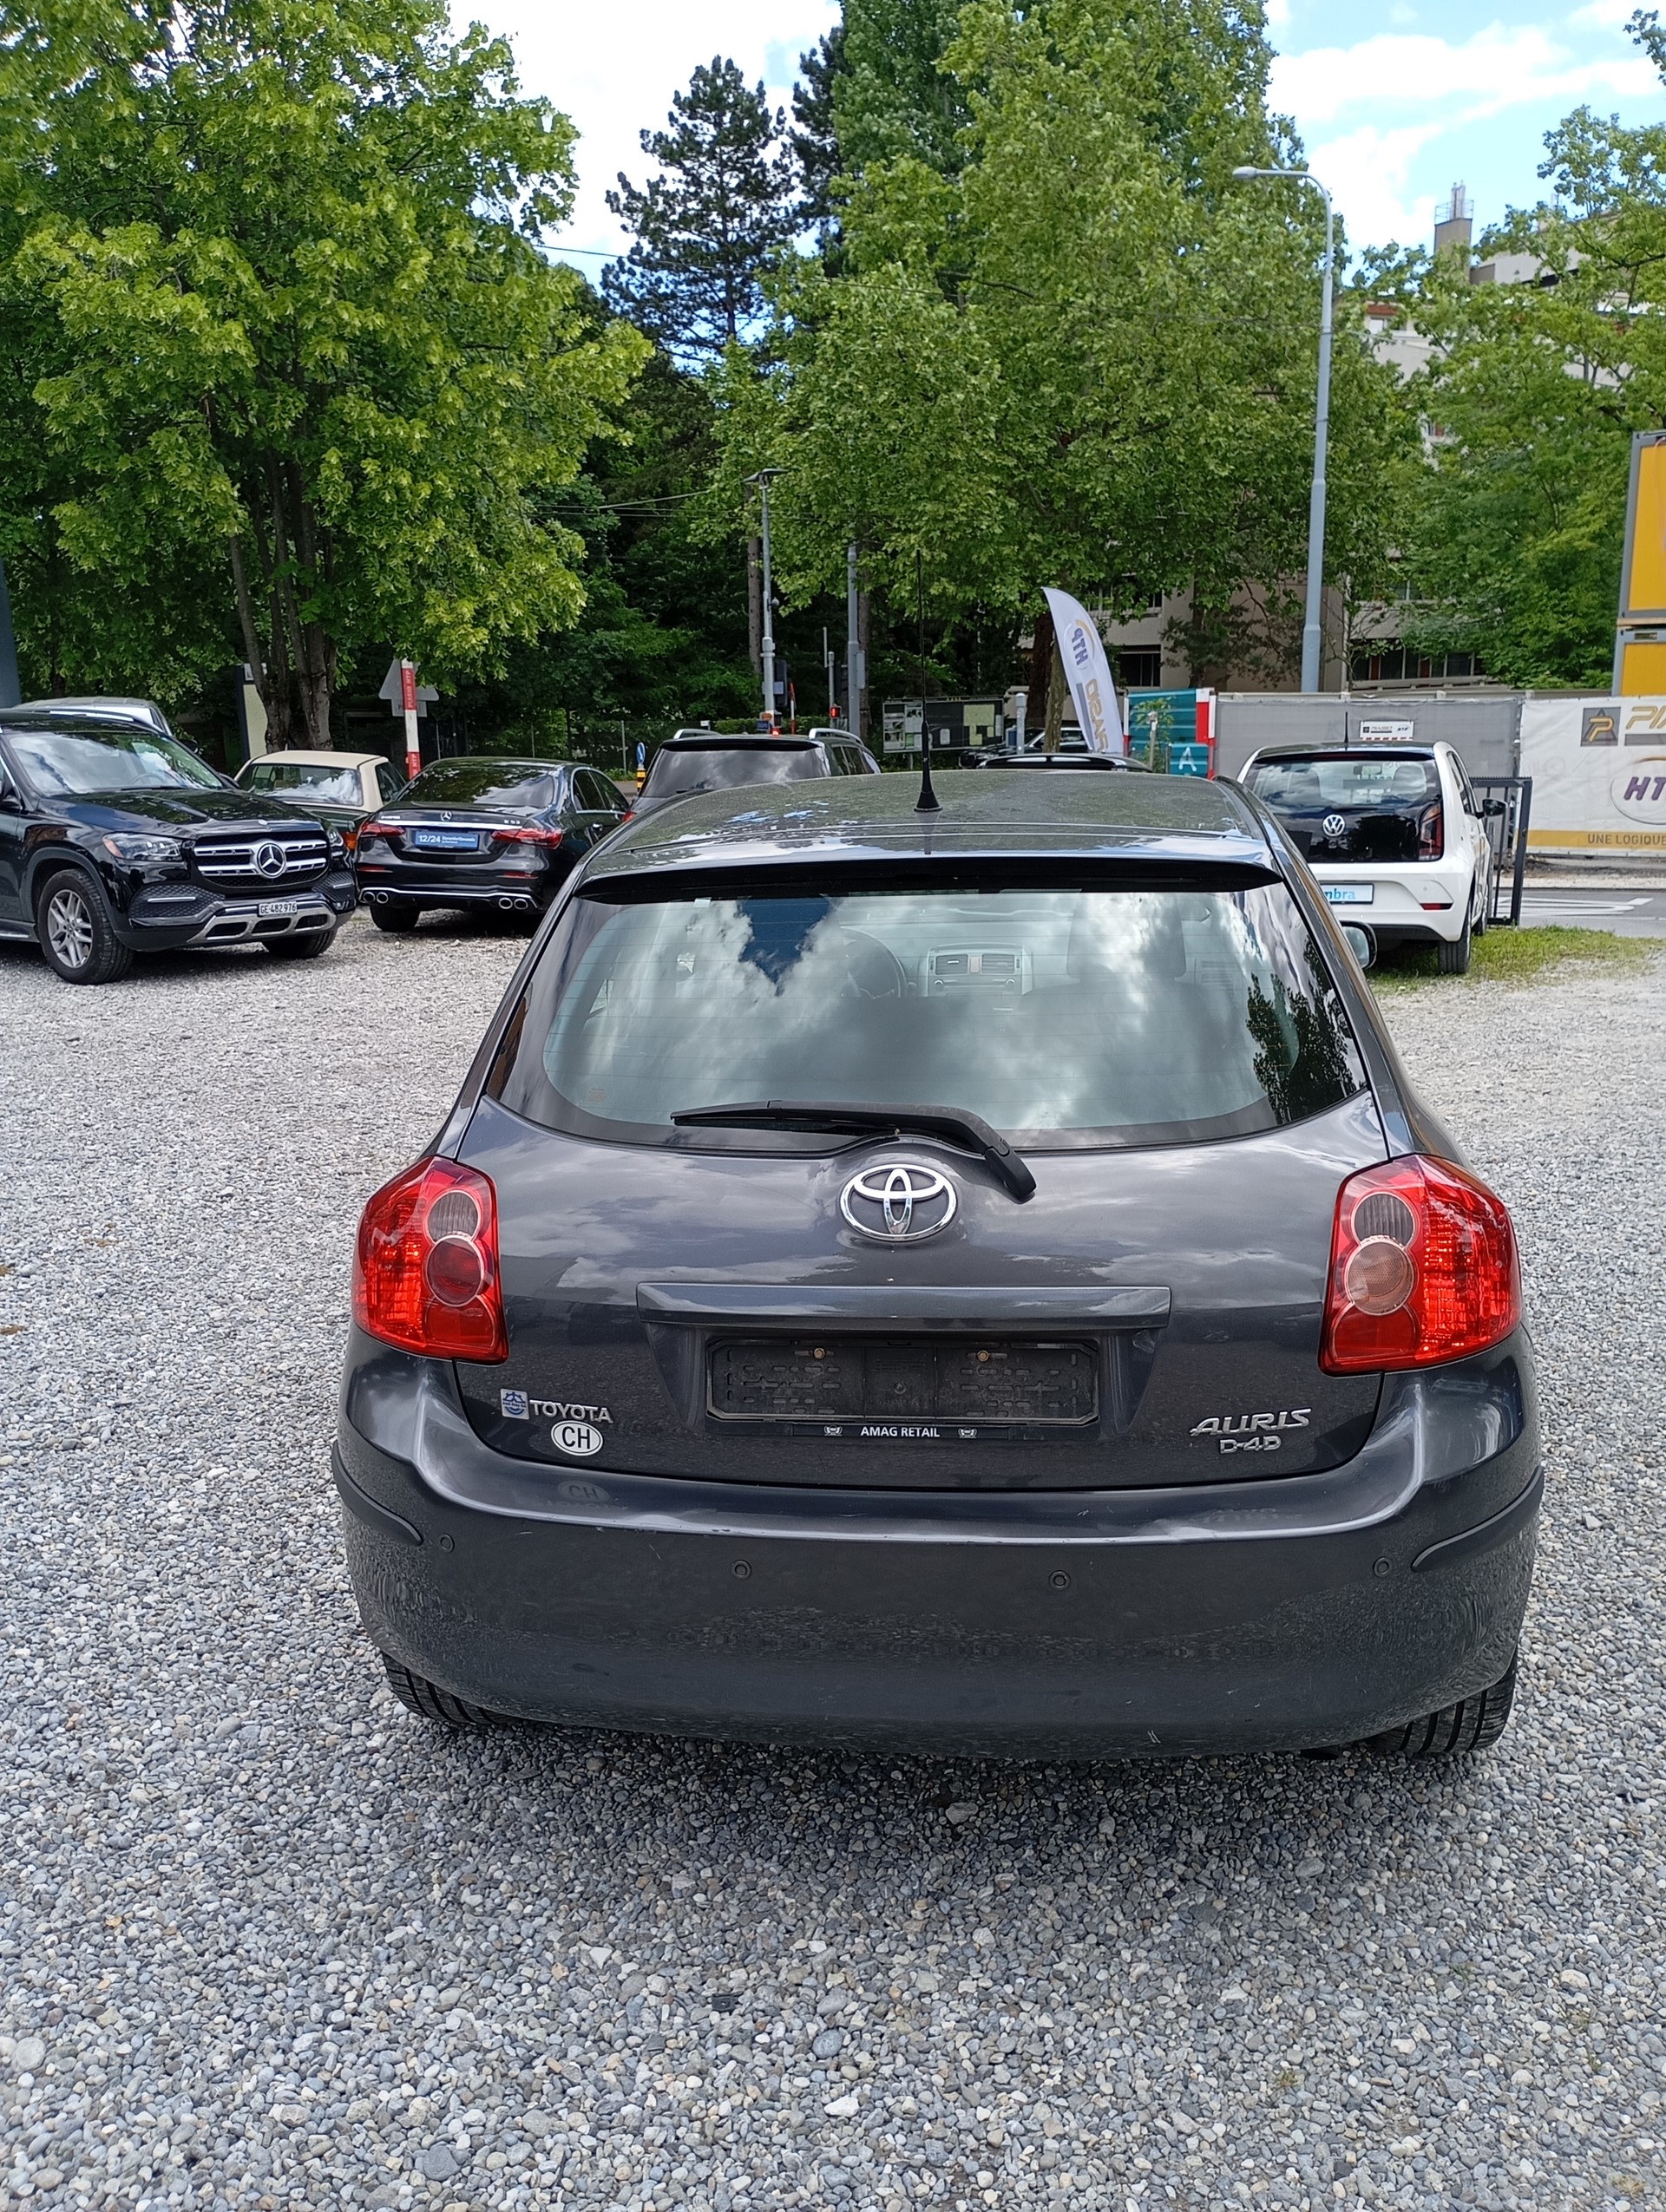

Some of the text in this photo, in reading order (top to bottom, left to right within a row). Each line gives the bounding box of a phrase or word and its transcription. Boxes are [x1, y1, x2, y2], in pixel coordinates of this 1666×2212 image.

[403, 670, 412, 684] HTP
[1178, 747, 1197, 772] A
[1623, 776, 1666, 801] HT
[418, 834, 441, 843] 12/24
[1588, 834, 1666, 846] UNE LOGIQUE
[1324, 887, 1356, 900] mbra
[529, 1399, 613, 1423] TOYOTA
[1190, 1408, 1312, 1436] AURIS
[561, 1425, 591, 1450] CH
[860, 1426, 940, 1438] AMAG RETAIL
[1219, 1436, 1282, 1454] D-4D
